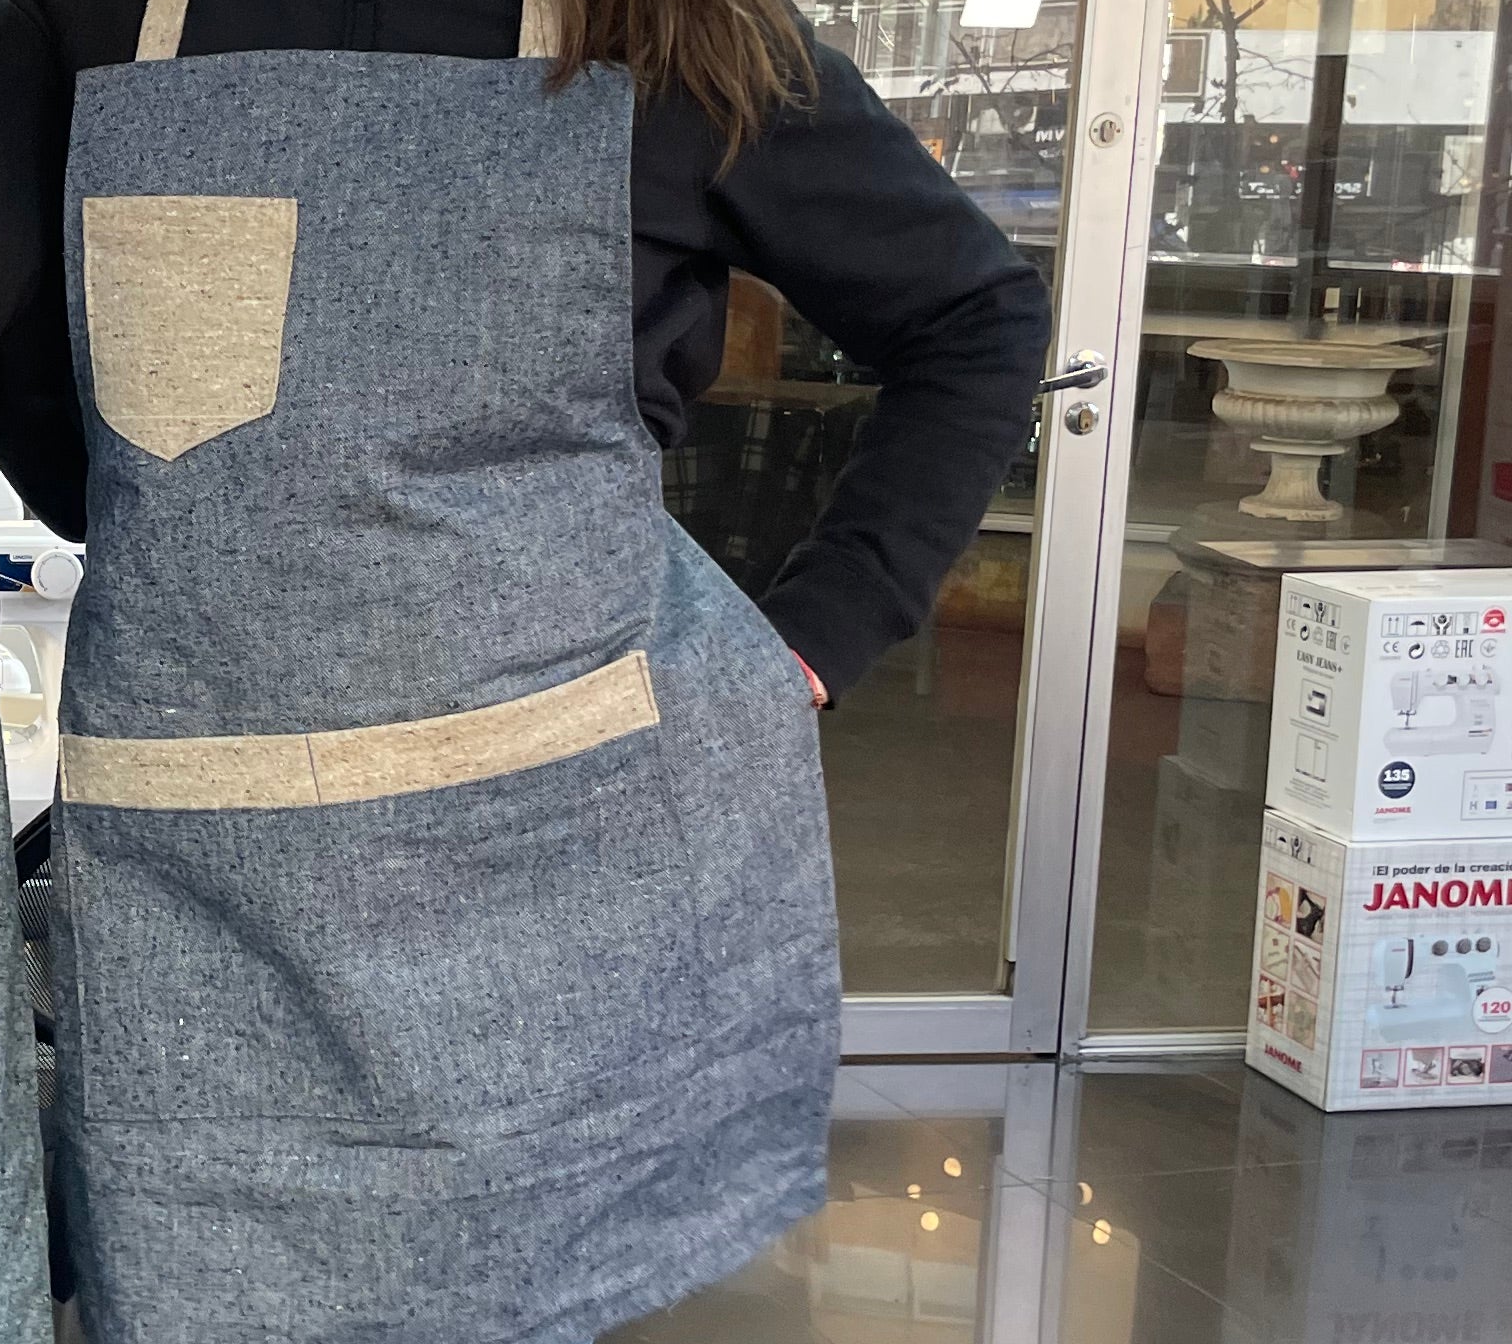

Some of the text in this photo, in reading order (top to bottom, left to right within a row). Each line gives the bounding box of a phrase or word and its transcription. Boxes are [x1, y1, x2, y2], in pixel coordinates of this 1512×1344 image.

[1384, 769, 1410, 782] 135
[1392, 865, 1430, 877] poder
[1434, 864, 1450, 873] de
[1454, 862, 1466, 873] la
[1482, 1001, 1511, 1014] 120
[1265, 1044, 1302, 1073] JANOME
